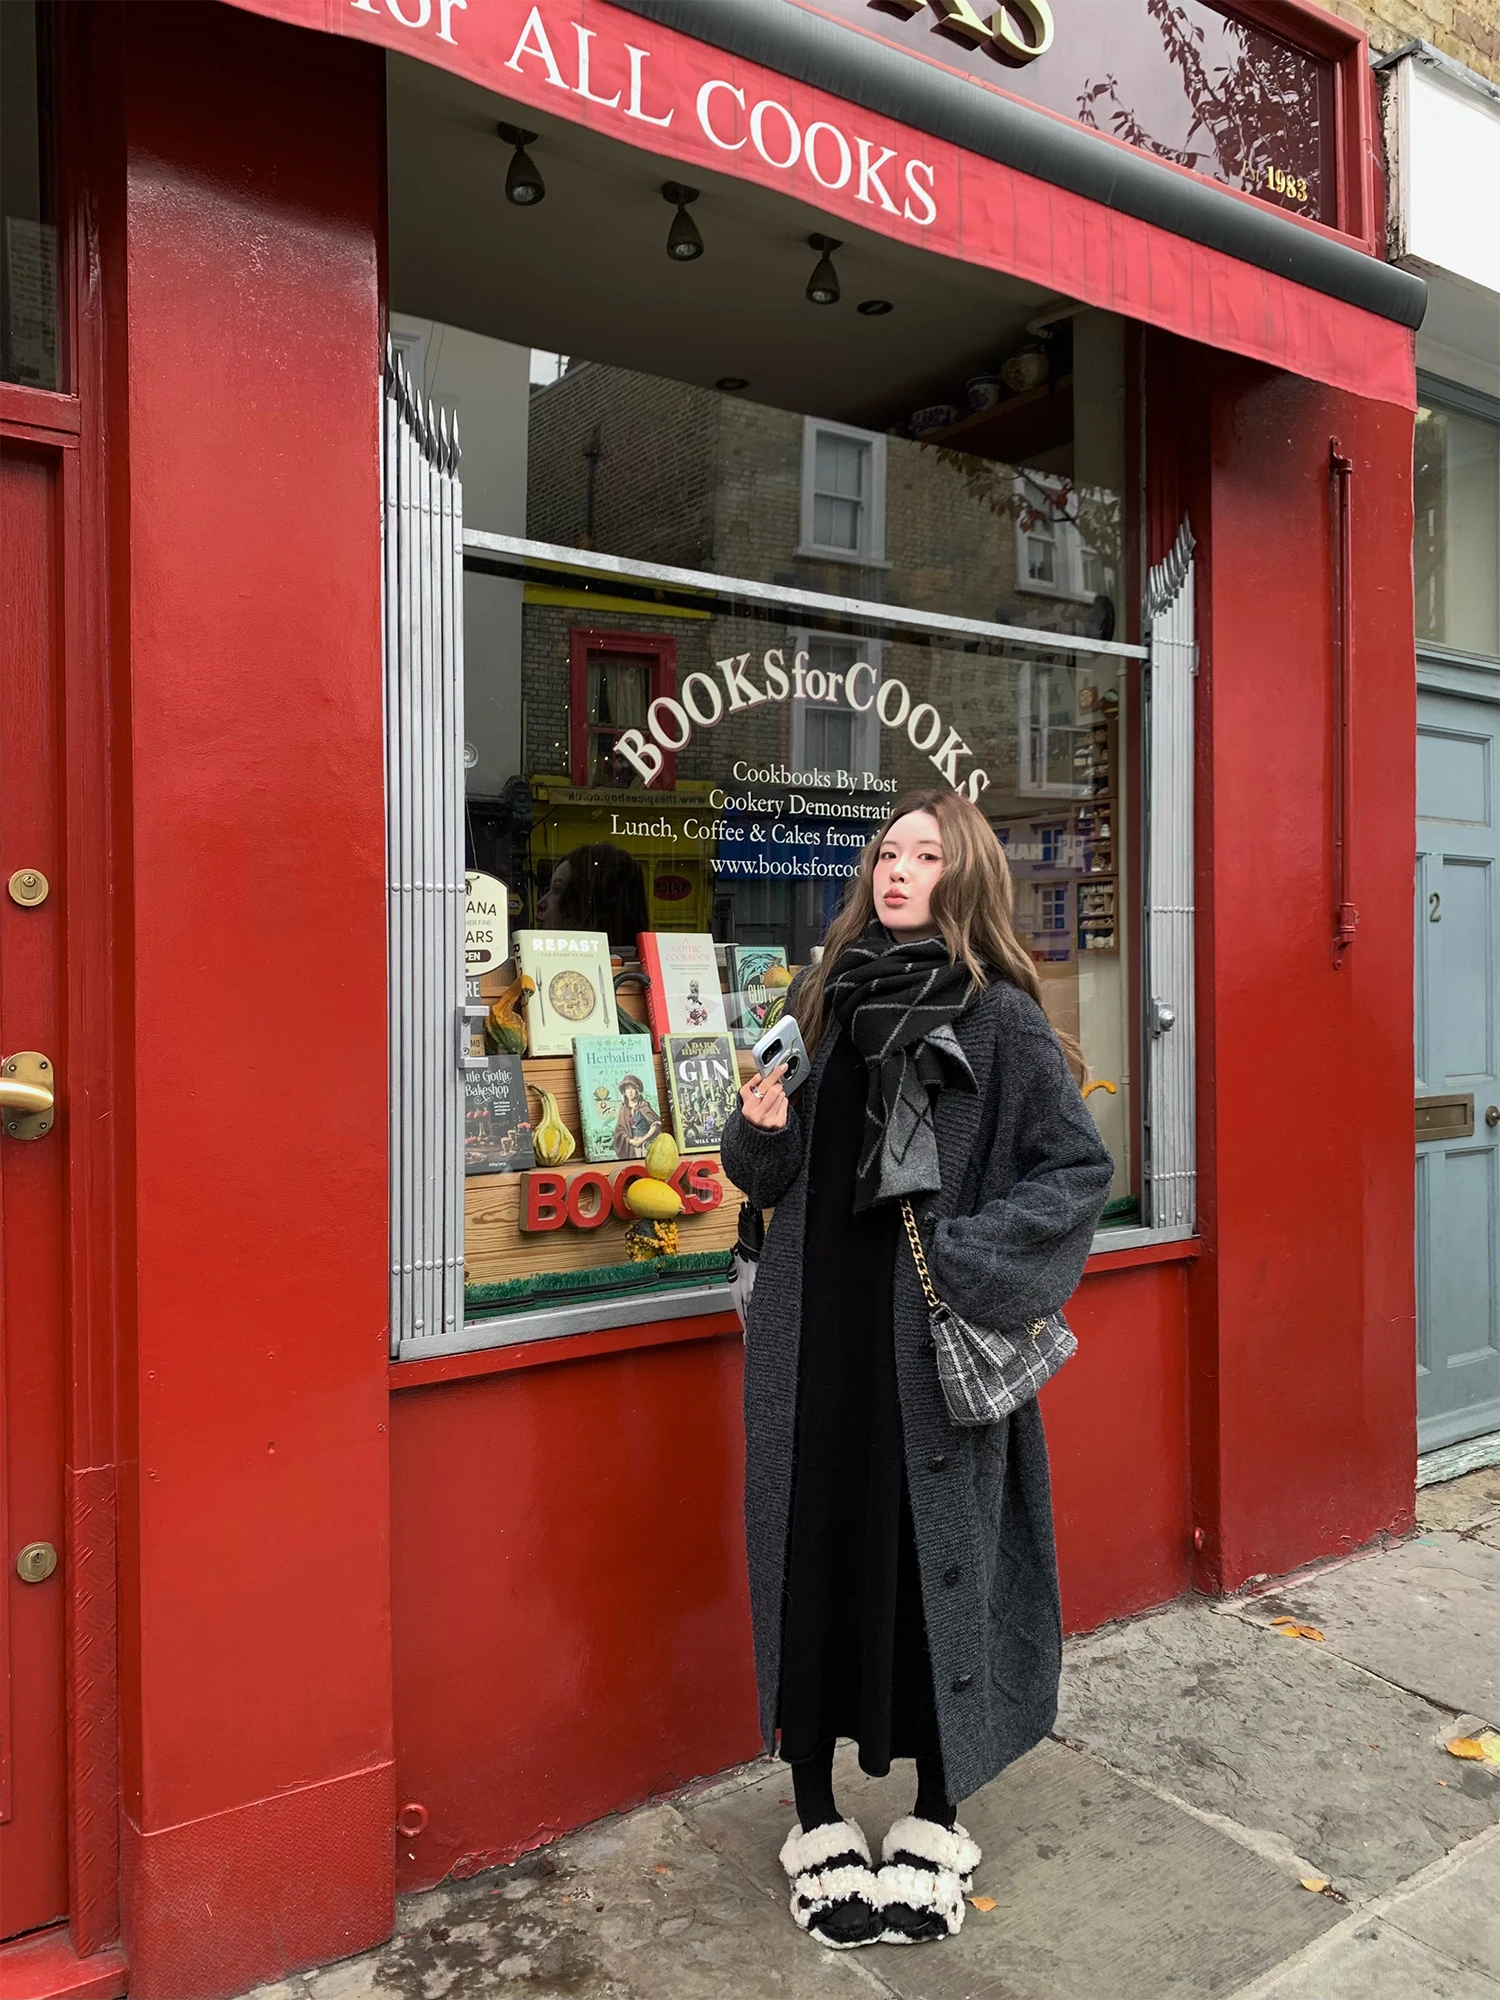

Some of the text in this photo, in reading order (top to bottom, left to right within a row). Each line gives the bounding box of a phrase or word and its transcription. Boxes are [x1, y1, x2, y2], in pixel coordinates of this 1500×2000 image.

[355, 0, 937, 225] or ALL COOKS
[1266, 165, 1308, 202] 1983
[733, 761, 898, 796] Cookbooks By Post
[709, 789, 785, 819] Cookery
[610, 814, 678, 843] Lunch,
[683, 819, 745, 841] Coffee
[750, 823, 767, 842] &
[771, 823, 821, 845] Cakes
[826, 826, 866, 847] from
[1429, 892, 1442, 923] 2
[532, 938, 599, 952] REPAST
[666, 953, 710, 962] COOKBOOK
[682, 1047, 721, 1056] HISTORY
[691, 1041, 717, 1050] DARK
[586, 1050, 646, 1064] Herbalism
[482, 1069, 513, 1085] Gothic
[678, 1059, 731, 1082] GIN
[465, 1083, 509, 1100] Bakeshop
